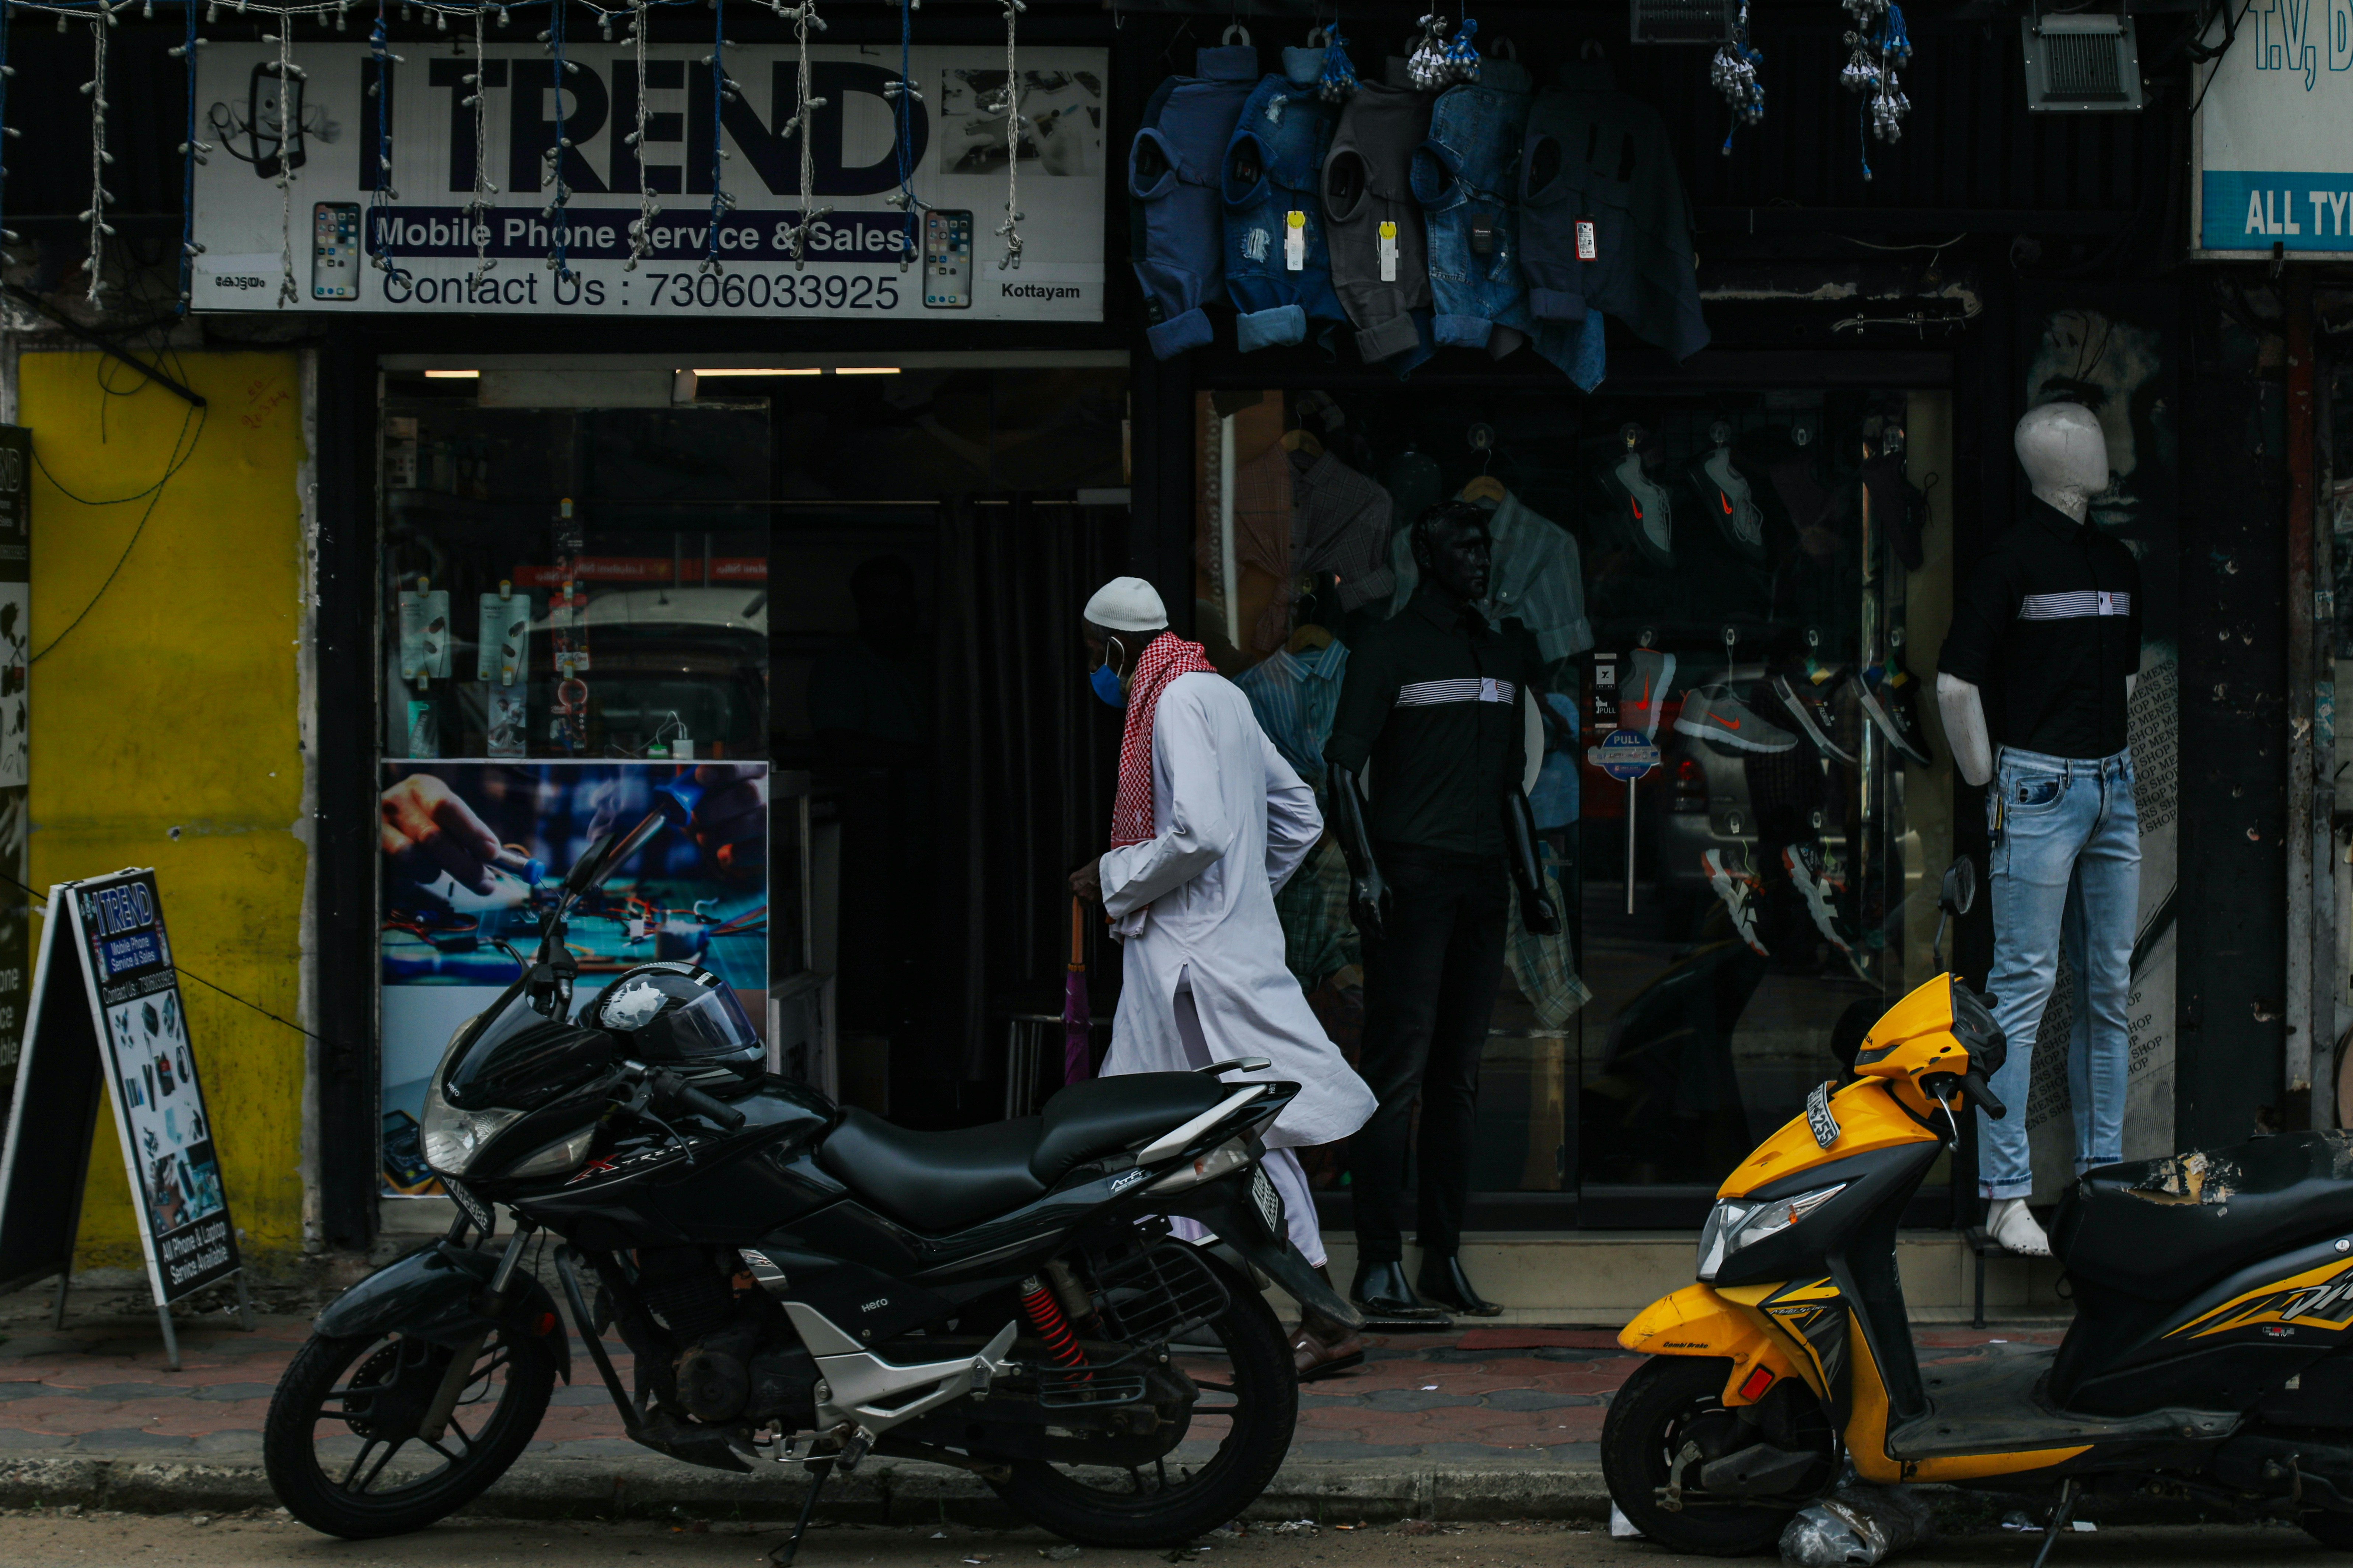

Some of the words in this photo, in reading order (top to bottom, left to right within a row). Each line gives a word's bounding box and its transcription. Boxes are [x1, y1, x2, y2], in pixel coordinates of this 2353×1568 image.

[359, 57, 394, 191] I
[429, 58, 929, 196] TREND
[2244, 190, 2300, 235] ALL
[2309, 191, 2353, 236] TY
[376, 217, 491, 246] Mobile
[504, 218, 615, 247] Phone
[772, 222, 797, 248] &
[809, 223, 905, 251] Sales
[215, 276, 265, 290] കോട്ടയം
[383, 269, 537, 305] Contact
[554, 272, 605, 306] Us
[646, 273, 898, 309] 7306033925
[1001, 283, 1080, 301] Kottayam
[2138, 701, 2172, 726] MENS
[1613, 736, 1640, 745] PULL
[2129, 721, 2160, 745] SHOP
[2139, 744, 2170, 767] SHOP
[2136, 787, 2166, 810] SHOP
[2145, 810, 2176, 833] SHOP
[99, 882, 154, 934] TREND
[111, 939, 131, 956] Mobile
[130, 936, 150, 950] Phone
[111, 955, 132, 972] Service
[139, 949, 156, 964] Sales
[102, 983, 127, 1004] Contact
[2128, 1014, 2152, 1034] HOP
[2131, 1036, 2162, 1059] SHOP
[447, 1081, 460, 1097] Hero
[1268, 1083, 1277, 1095] Hero
[2027, 1092, 2062, 1116] MENS
[162, 1240, 175, 1263] All
[171, 1235, 198, 1258] Phone
[200, 1221, 227, 1246] Laptop
[170, 1259, 199, 1285] Service
[196, 1243, 230, 1273] Available
[861, 1298, 888, 1313] Hero
